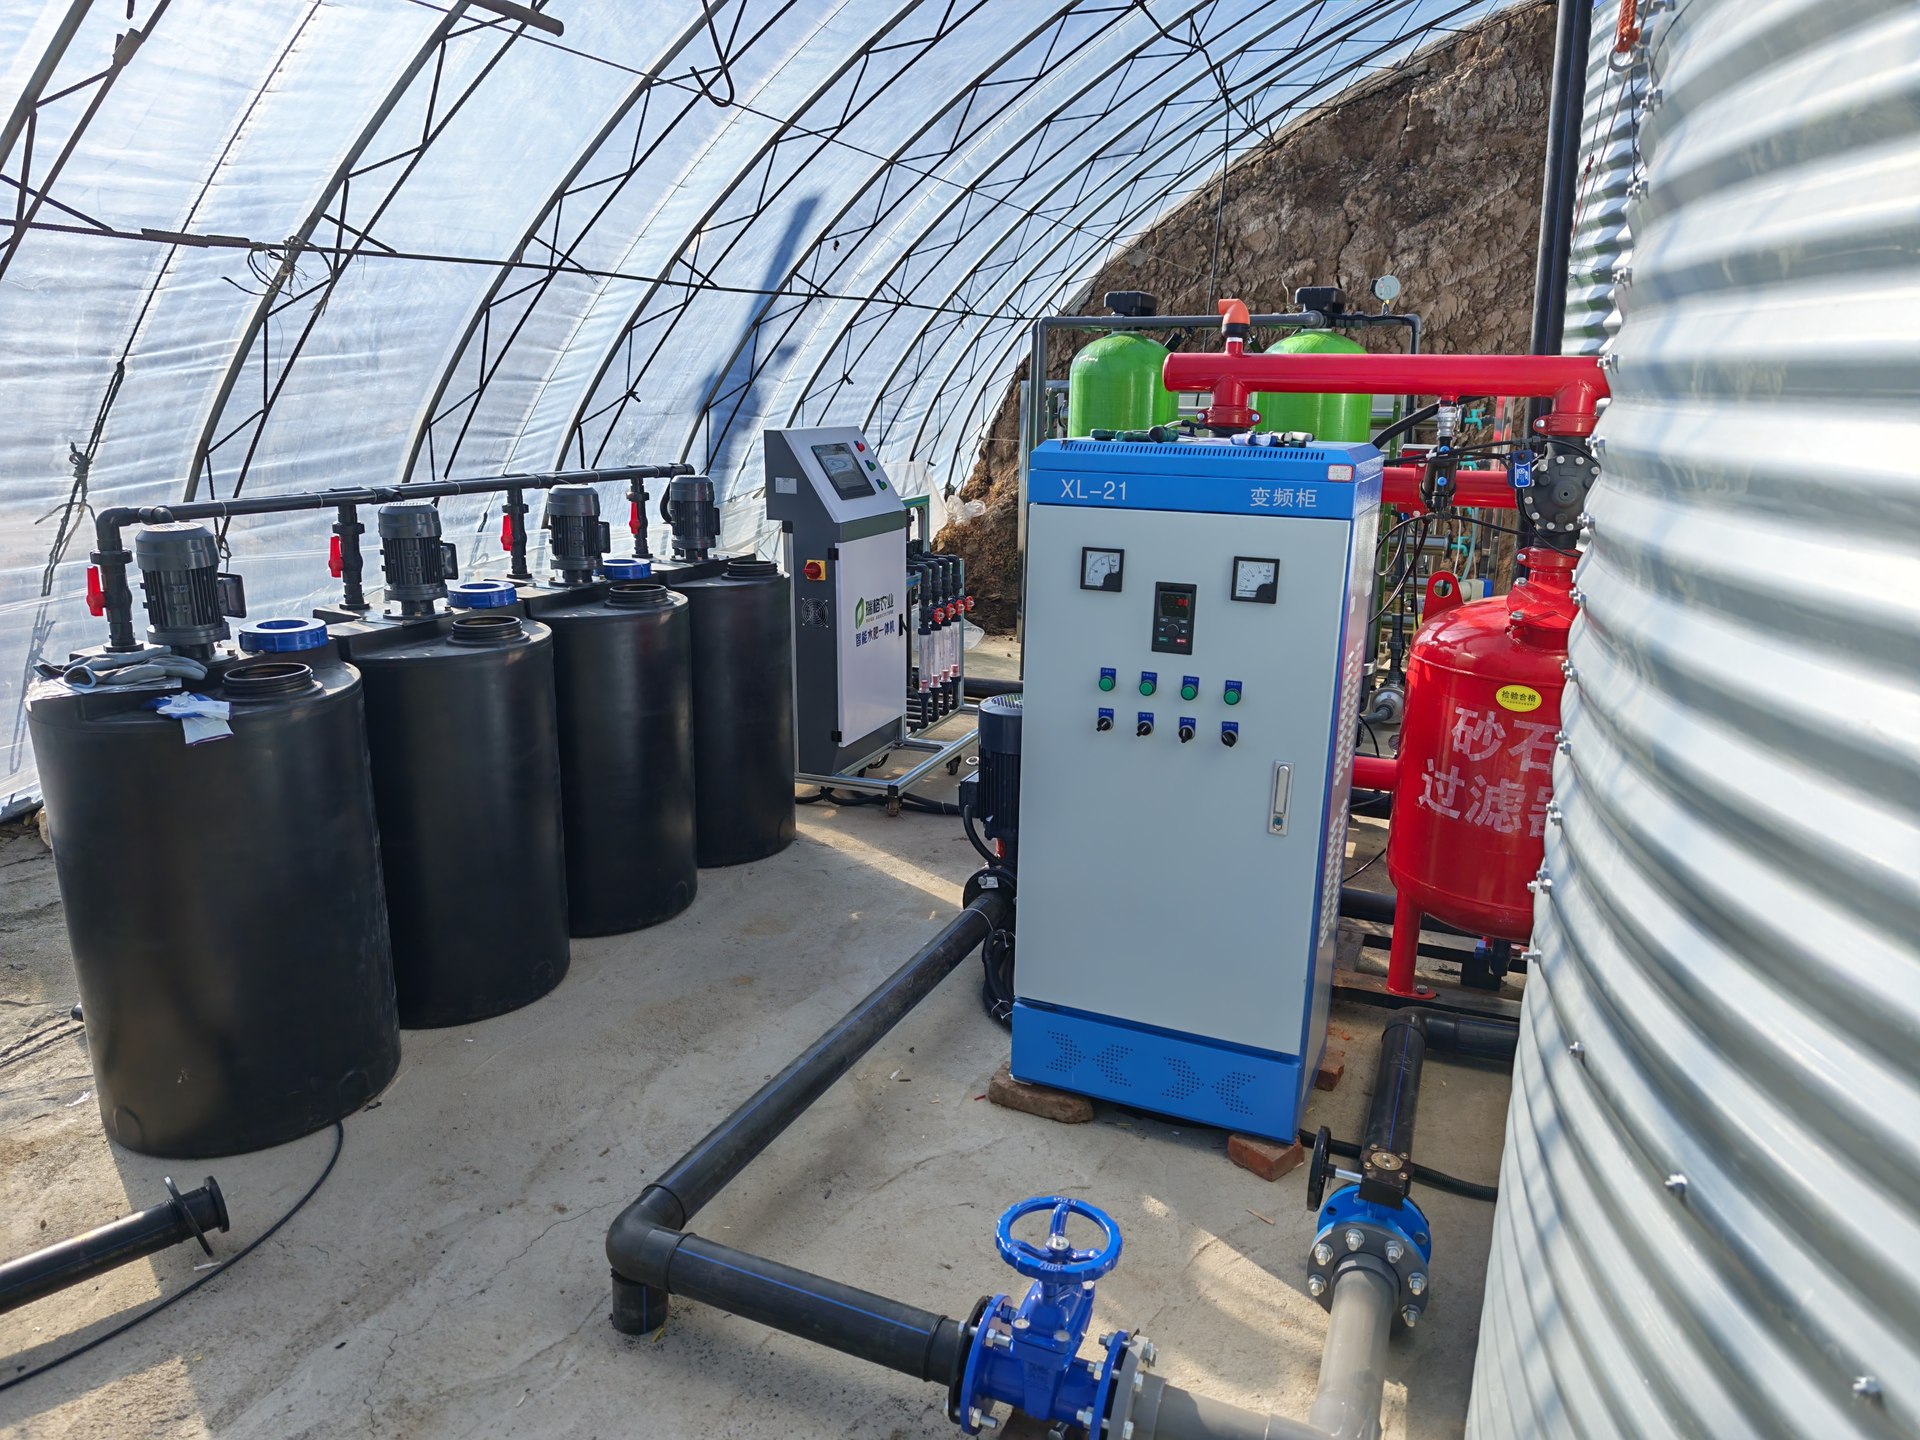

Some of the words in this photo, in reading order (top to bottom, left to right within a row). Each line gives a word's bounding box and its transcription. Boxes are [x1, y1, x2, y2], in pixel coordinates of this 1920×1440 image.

[1060, 478, 1126, 500] XL-21
[1249, 486, 1318, 508] 变频柜
[865, 592, 894, 617] 瑞格农业
[855, 620, 895, 647] 智能水肥一体机
[1501, 690, 1537, 703] 检验合格
[1452, 707, 1562, 774] 砂石
